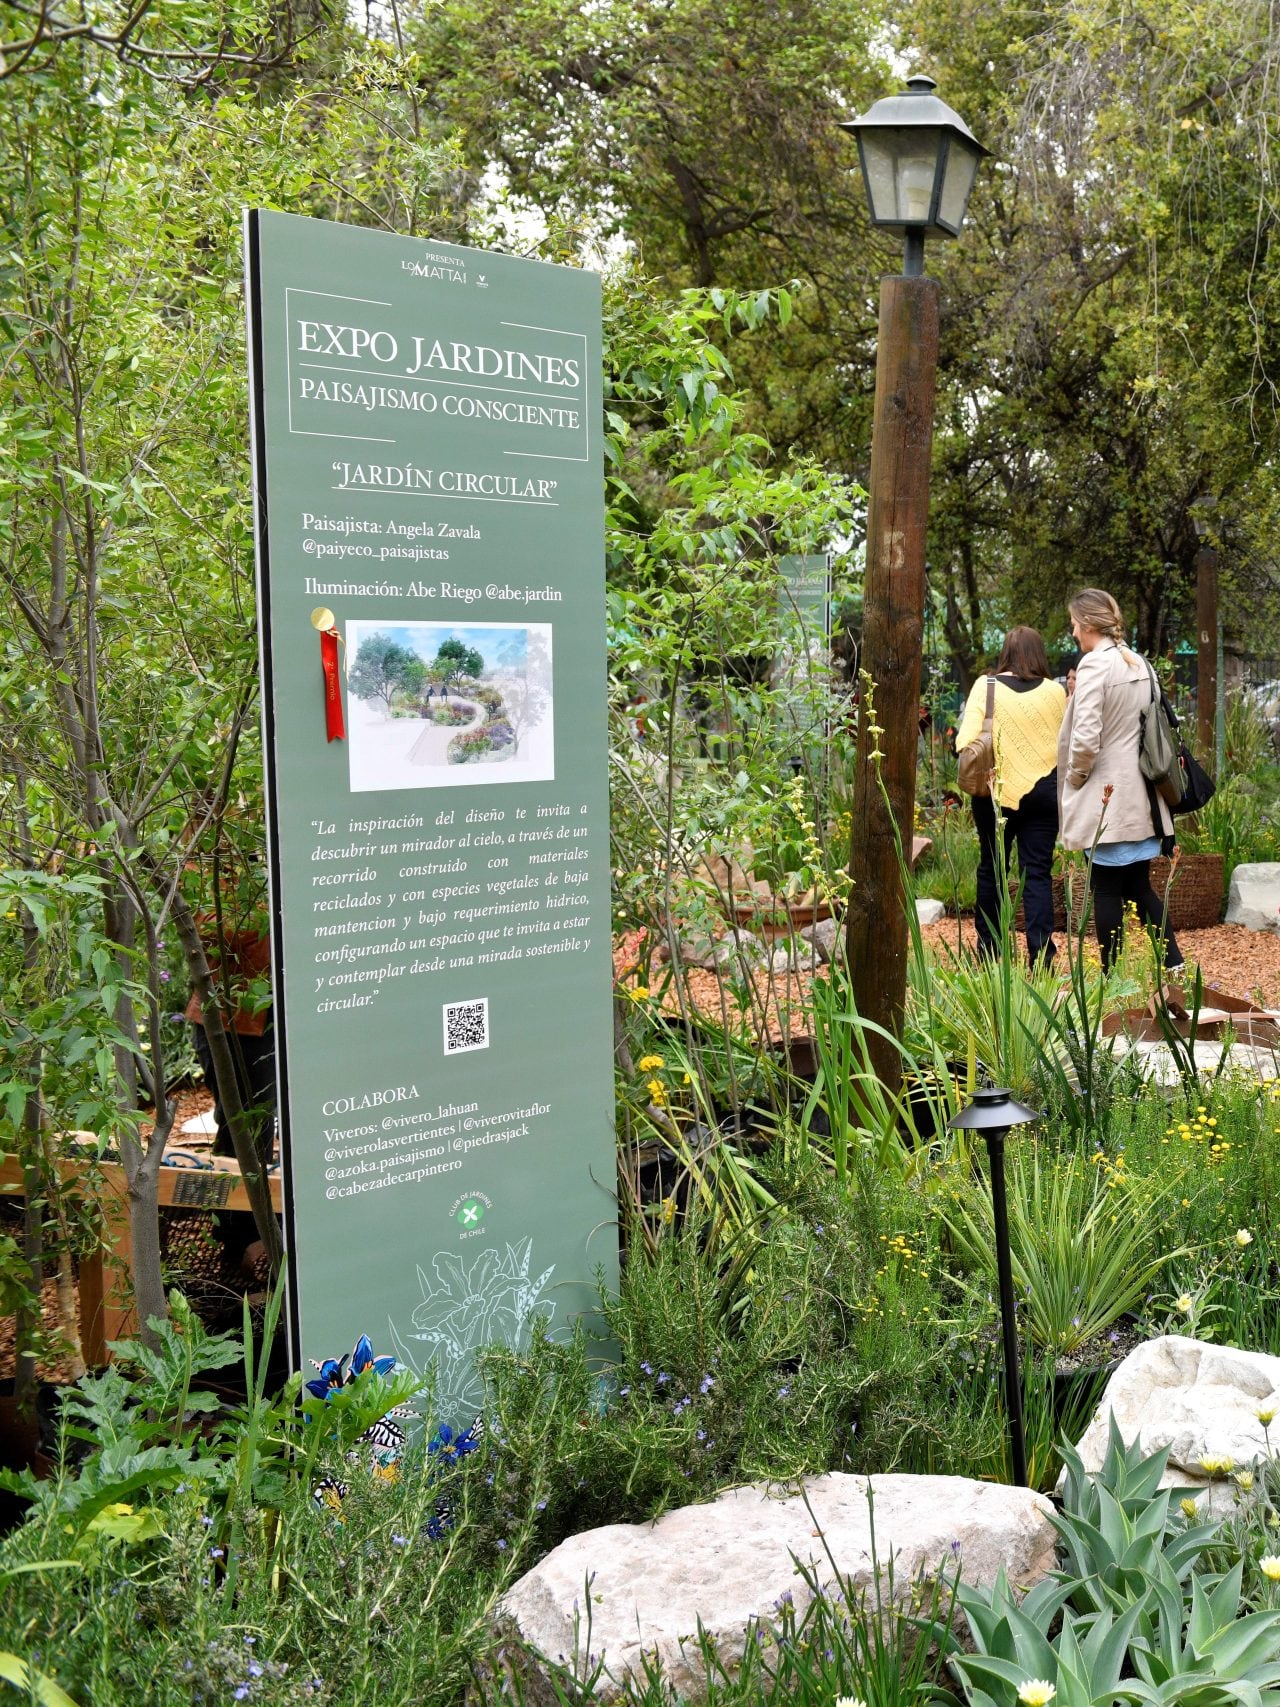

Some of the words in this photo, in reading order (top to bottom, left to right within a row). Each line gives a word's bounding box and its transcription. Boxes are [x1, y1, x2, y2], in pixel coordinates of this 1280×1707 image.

[425, 252, 465, 267] PRESENTA
[297, 319, 398, 363] EXPO
[405, 336, 580, 388] JARDINES
[299, 378, 437, 413] PAISAJISMO
[442, 394, 580, 430] CONSCIENTE
[331, 461, 433, 489] “JARDÍN
[438, 471, 558, 499] CIRCULAR”
[302, 513, 383, 537] Paisajista:
[386, 521, 435, 540] Angela
[438, 522, 481, 540] Zavala
[302, 539, 450, 563] @paiyeco_paisajistas
[304, 577, 403, 597] Iluminación:
[407, 580, 437, 598] Abe
[440, 582, 482, 603] Riego
[485, 584, 563, 604] @abe.jardin
[311, 820, 336, 835] “La
[348, 813, 424, 835] inspiración
[435, 810, 455, 825] del
[465, 808, 505, 823] diseño
[515, 807, 527, 819] te
[536, 804, 570, 817] invita
[580, 804, 587, 814] a
[311, 843, 377, 861] descubrir
[380, 843, 398, 855] un
[401, 836, 456, 853] mirador
[458, 833, 471, 848] al
[473, 831, 505, 846] cielo,
[507, 833, 515, 843] a
[519, 827, 554, 842] través
[556, 825, 570, 839] de
[573, 827, 588, 838] un
[312, 867, 377, 886] recorrido
[399, 858, 467, 878] construido
[487, 857, 509, 869] con
[528, 847, 589, 864] materiales
[313, 892, 382, 912] reciclados
[387, 893, 396, 908] y
[402, 890, 425, 902] con
[431, 882, 481, 902] especies
[486, 875, 539, 895] vegetales
[544, 872, 558, 886] de
[564, 869, 589, 887] baja
[402, 916, 412, 931] y
[418, 909, 447, 927] bajo
[453, 900, 540, 922] requerimiento
[315, 938, 406, 965] configurando
[409, 939, 426, 950] un
[429, 930, 475, 950] espacio
[477, 928, 500, 945] que
[503, 926, 514, 937] te
[516, 920, 551, 936] invita
[553, 920, 561, 930] a
[563, 916, 591, 929] estar
[315, 977, 324, 993] y
[328, 963, 406, 984] contemplar
[410, 957, 446, 974] desde
[449, 956, 474, 969] una
[478, 945, 522, 964] mirada
[525, 937, 581, 957] sostenible
[583, 939, 591, 953] y
[316, 989, 380, 1013] circular.”
[322, 1084, 420, 1117] COLABORA
[323, 1124, 378, 1143] Viveros:
[381, 1101, 479, 1130] @vivero_lahuan
[324, 1125, 456, 1162] @viverolasvertientes
[325, 1145, 445, 1181] @azoka.paisajismo
[452, 1124, 529, 1153] @piedrasjack
[326, 1159, 463, 1200] @cabezadecarpintero
